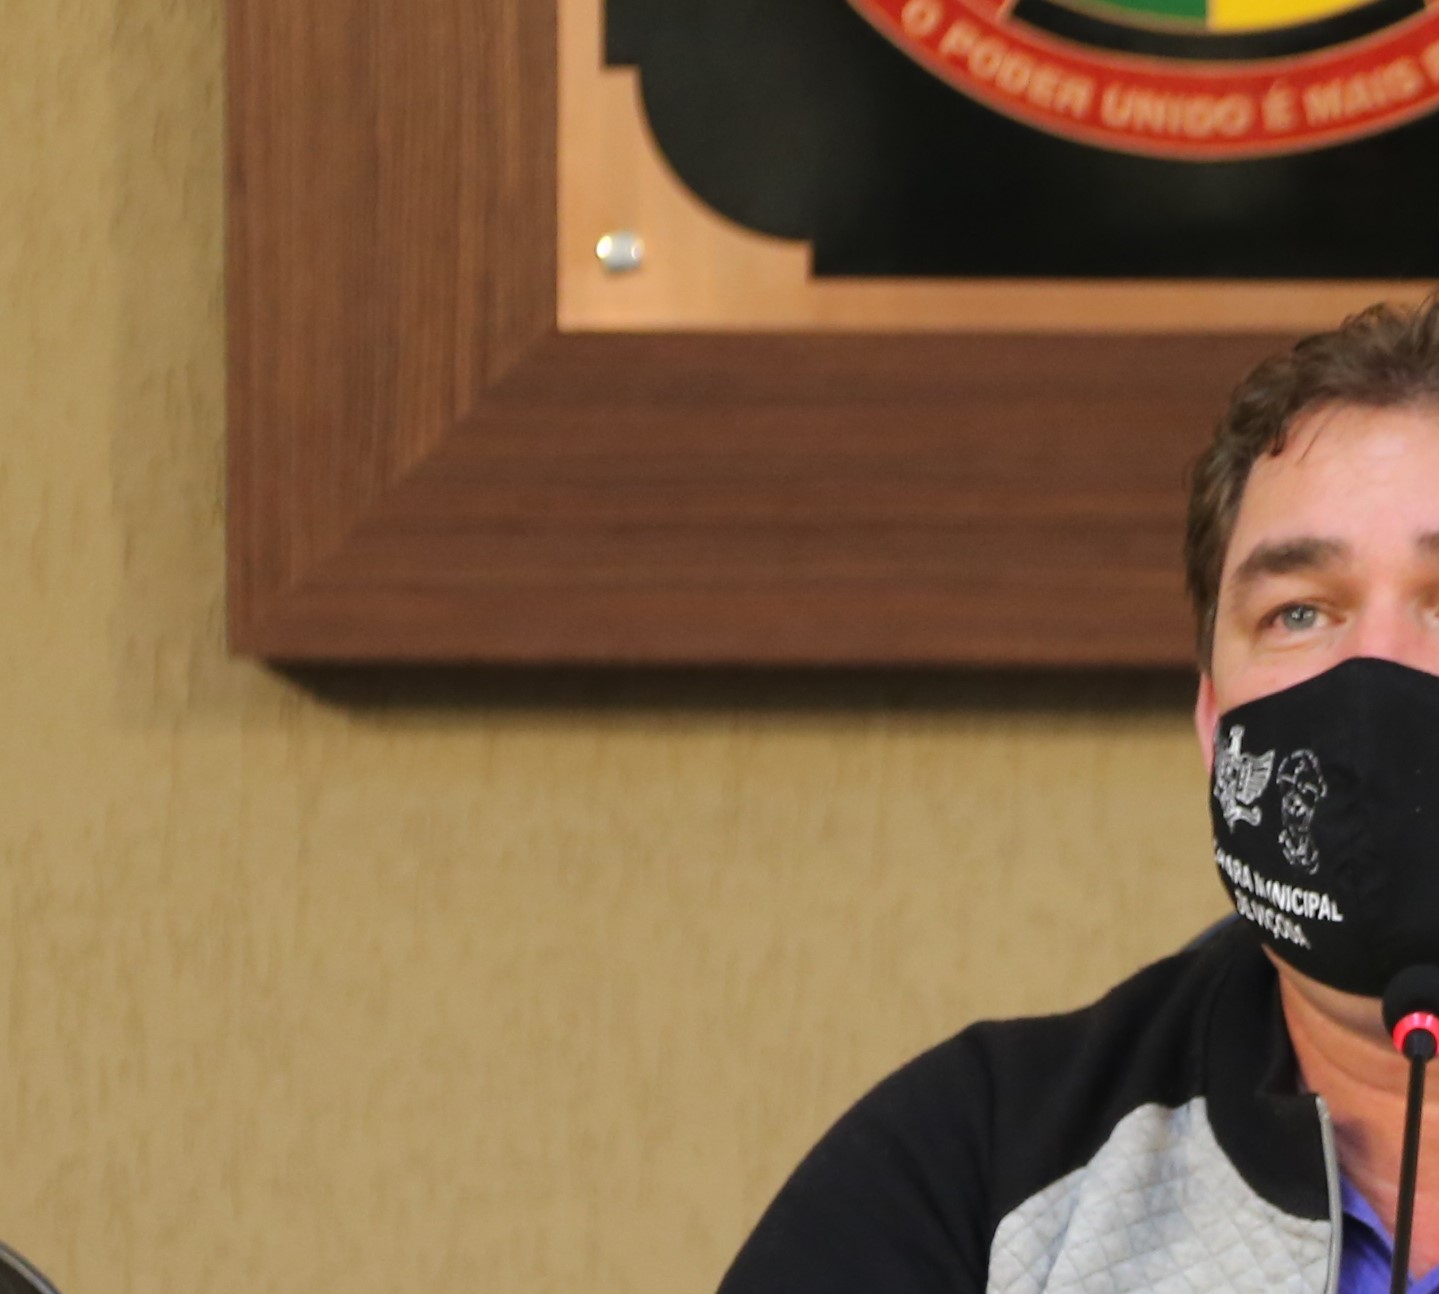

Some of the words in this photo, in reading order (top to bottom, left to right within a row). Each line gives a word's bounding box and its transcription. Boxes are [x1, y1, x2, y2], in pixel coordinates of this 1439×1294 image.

[901, 0, 943, 38] O
[938, 18, 1095, 119] PODER
[1101, 81, 1253, 139] UNIDO
[1261, 77, 1296, 133] É
[1302, 55, 1424, 128] MAIS
[1252, 869, 1344, 922] MUNICIPAL
